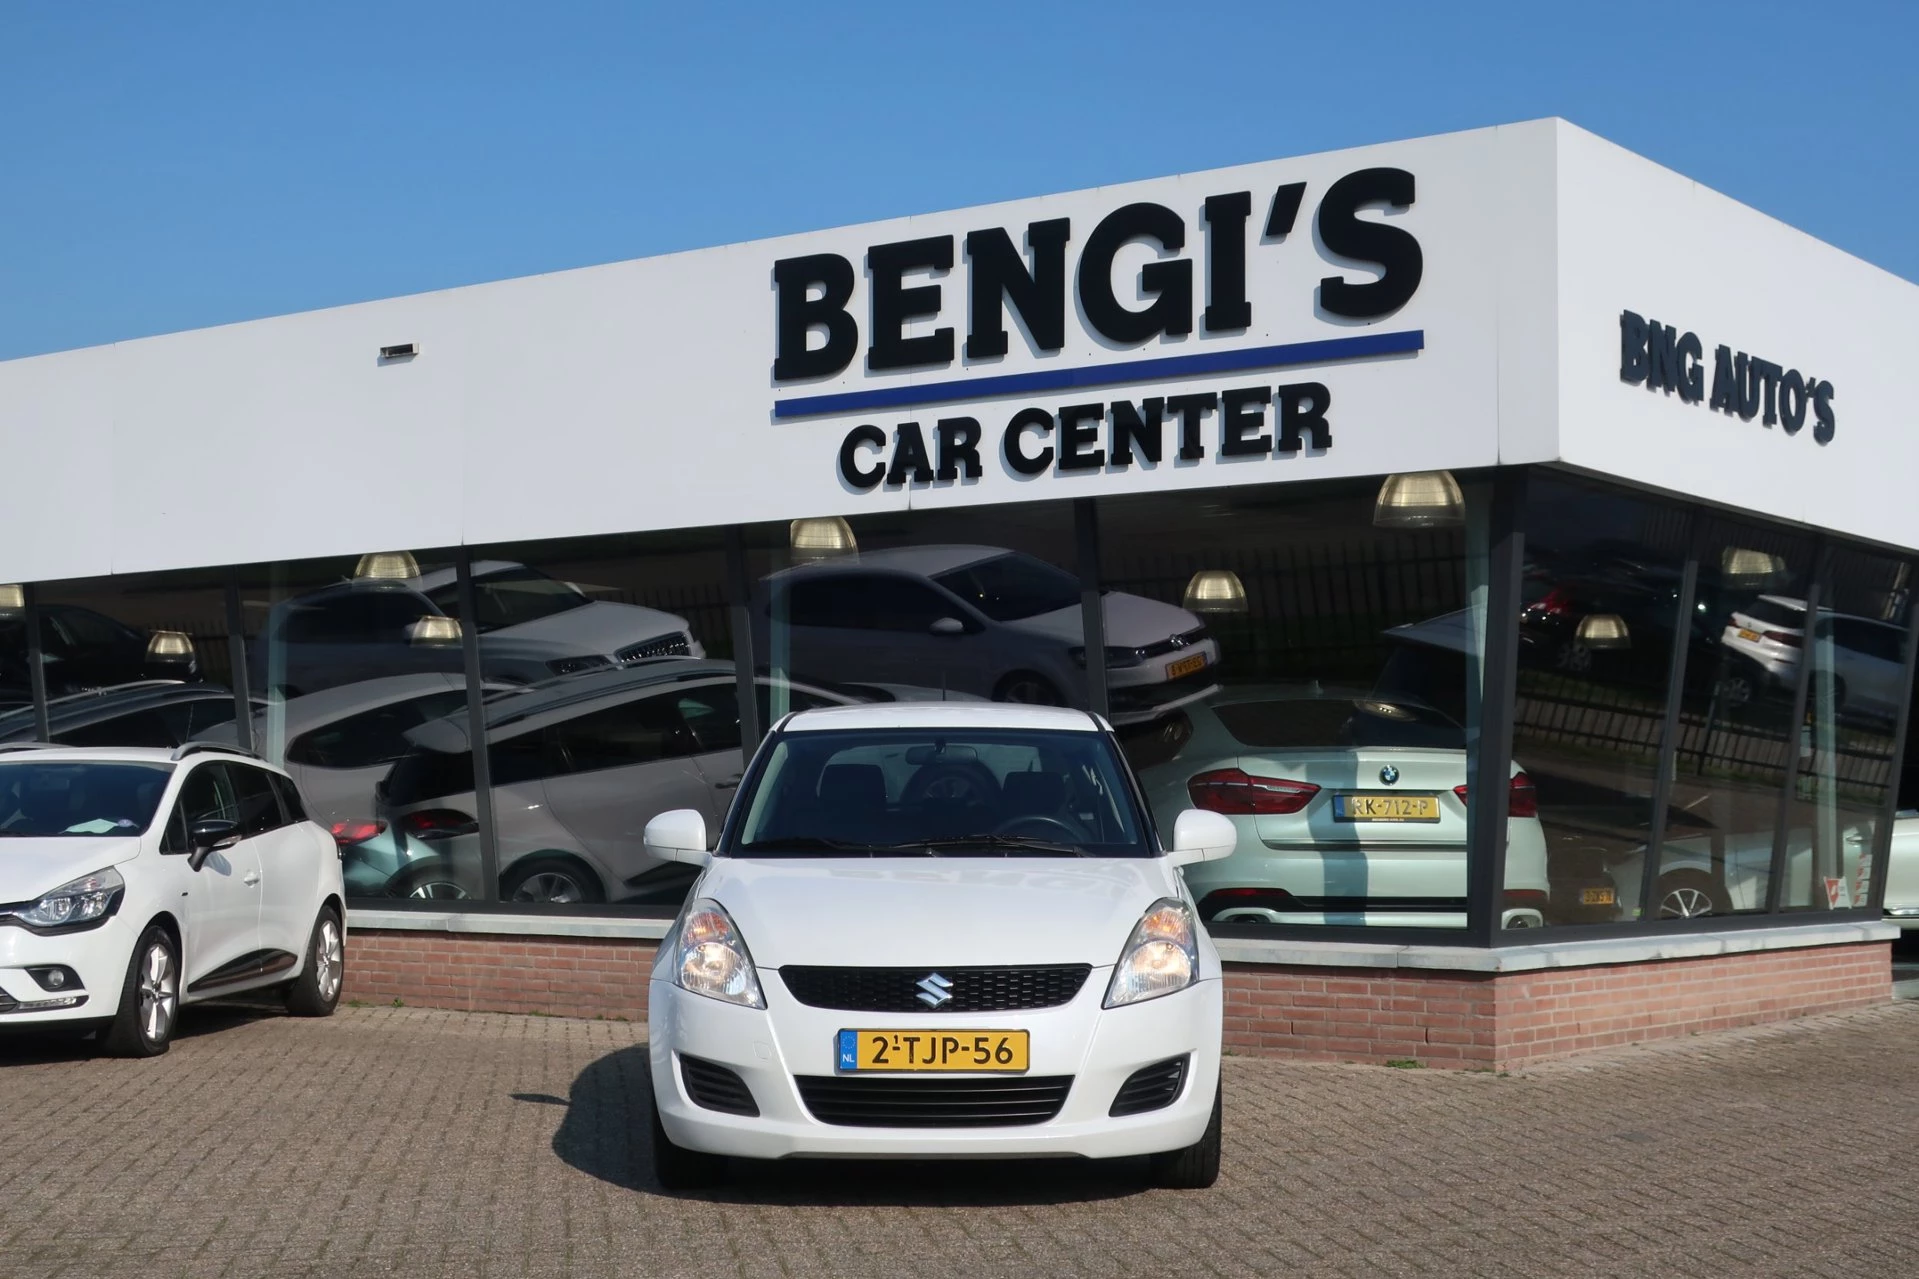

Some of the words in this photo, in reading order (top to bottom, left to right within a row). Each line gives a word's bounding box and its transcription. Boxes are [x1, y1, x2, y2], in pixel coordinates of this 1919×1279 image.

[773, 166, 1424, 381] BENGI'S
[1620, 309, 1704, 404] BNG
[1709, 343, 1836, 446] AUTO'S
[839, 415, 983, 488] CAR
[1003, 381, 1333, 475] CENTER
[1351, 798, 1429, 816] RK-712-P
[842, 1053, 856, 1064] NL
